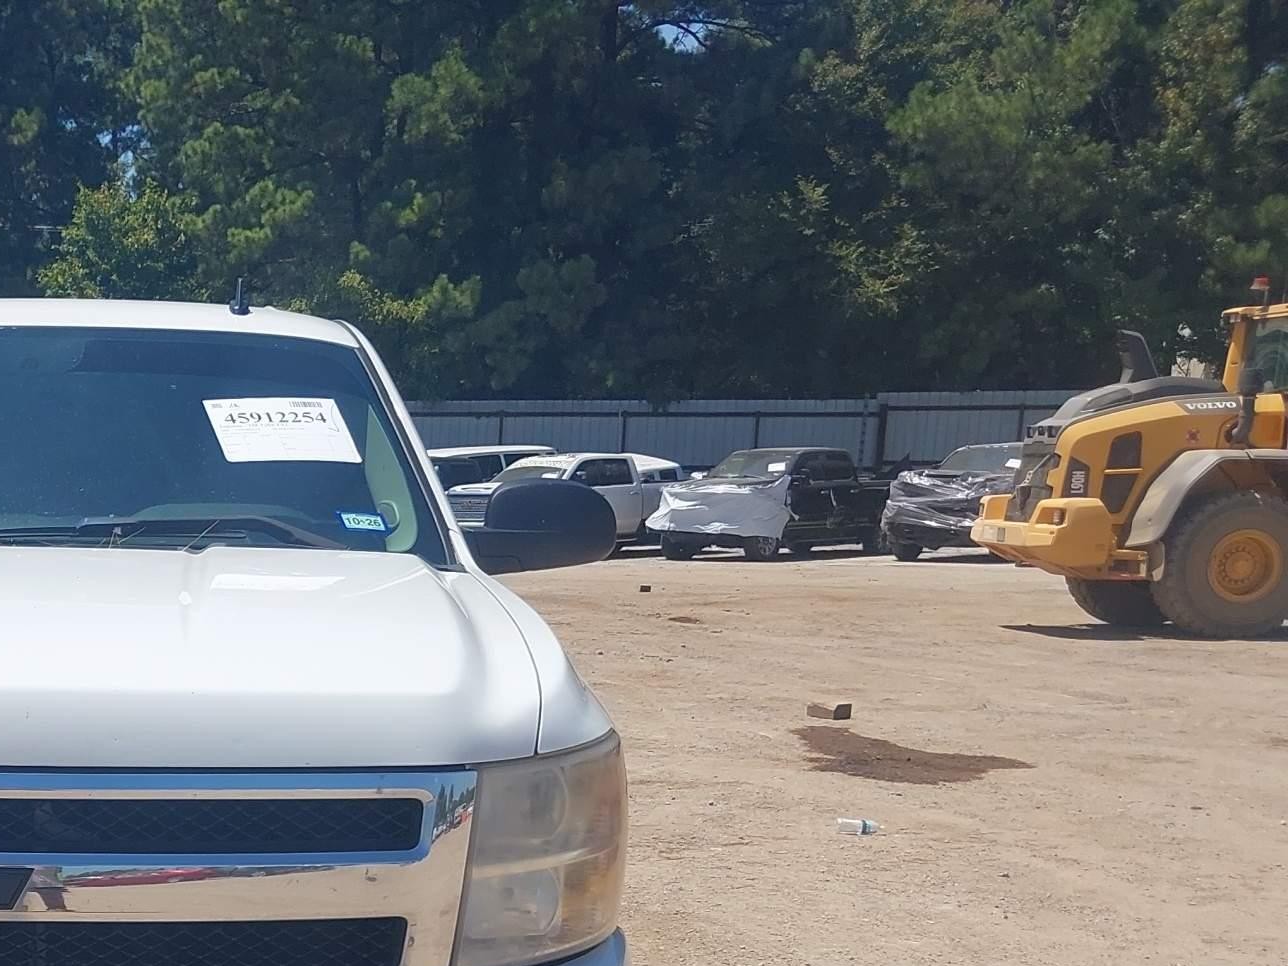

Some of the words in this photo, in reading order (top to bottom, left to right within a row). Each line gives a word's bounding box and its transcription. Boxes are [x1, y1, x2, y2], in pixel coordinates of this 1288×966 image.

[1184, 401, 1237, 410] VOLVO
[224, 411, 328, 424] 45912254
[1070, 470, 1086, 494] L90H
